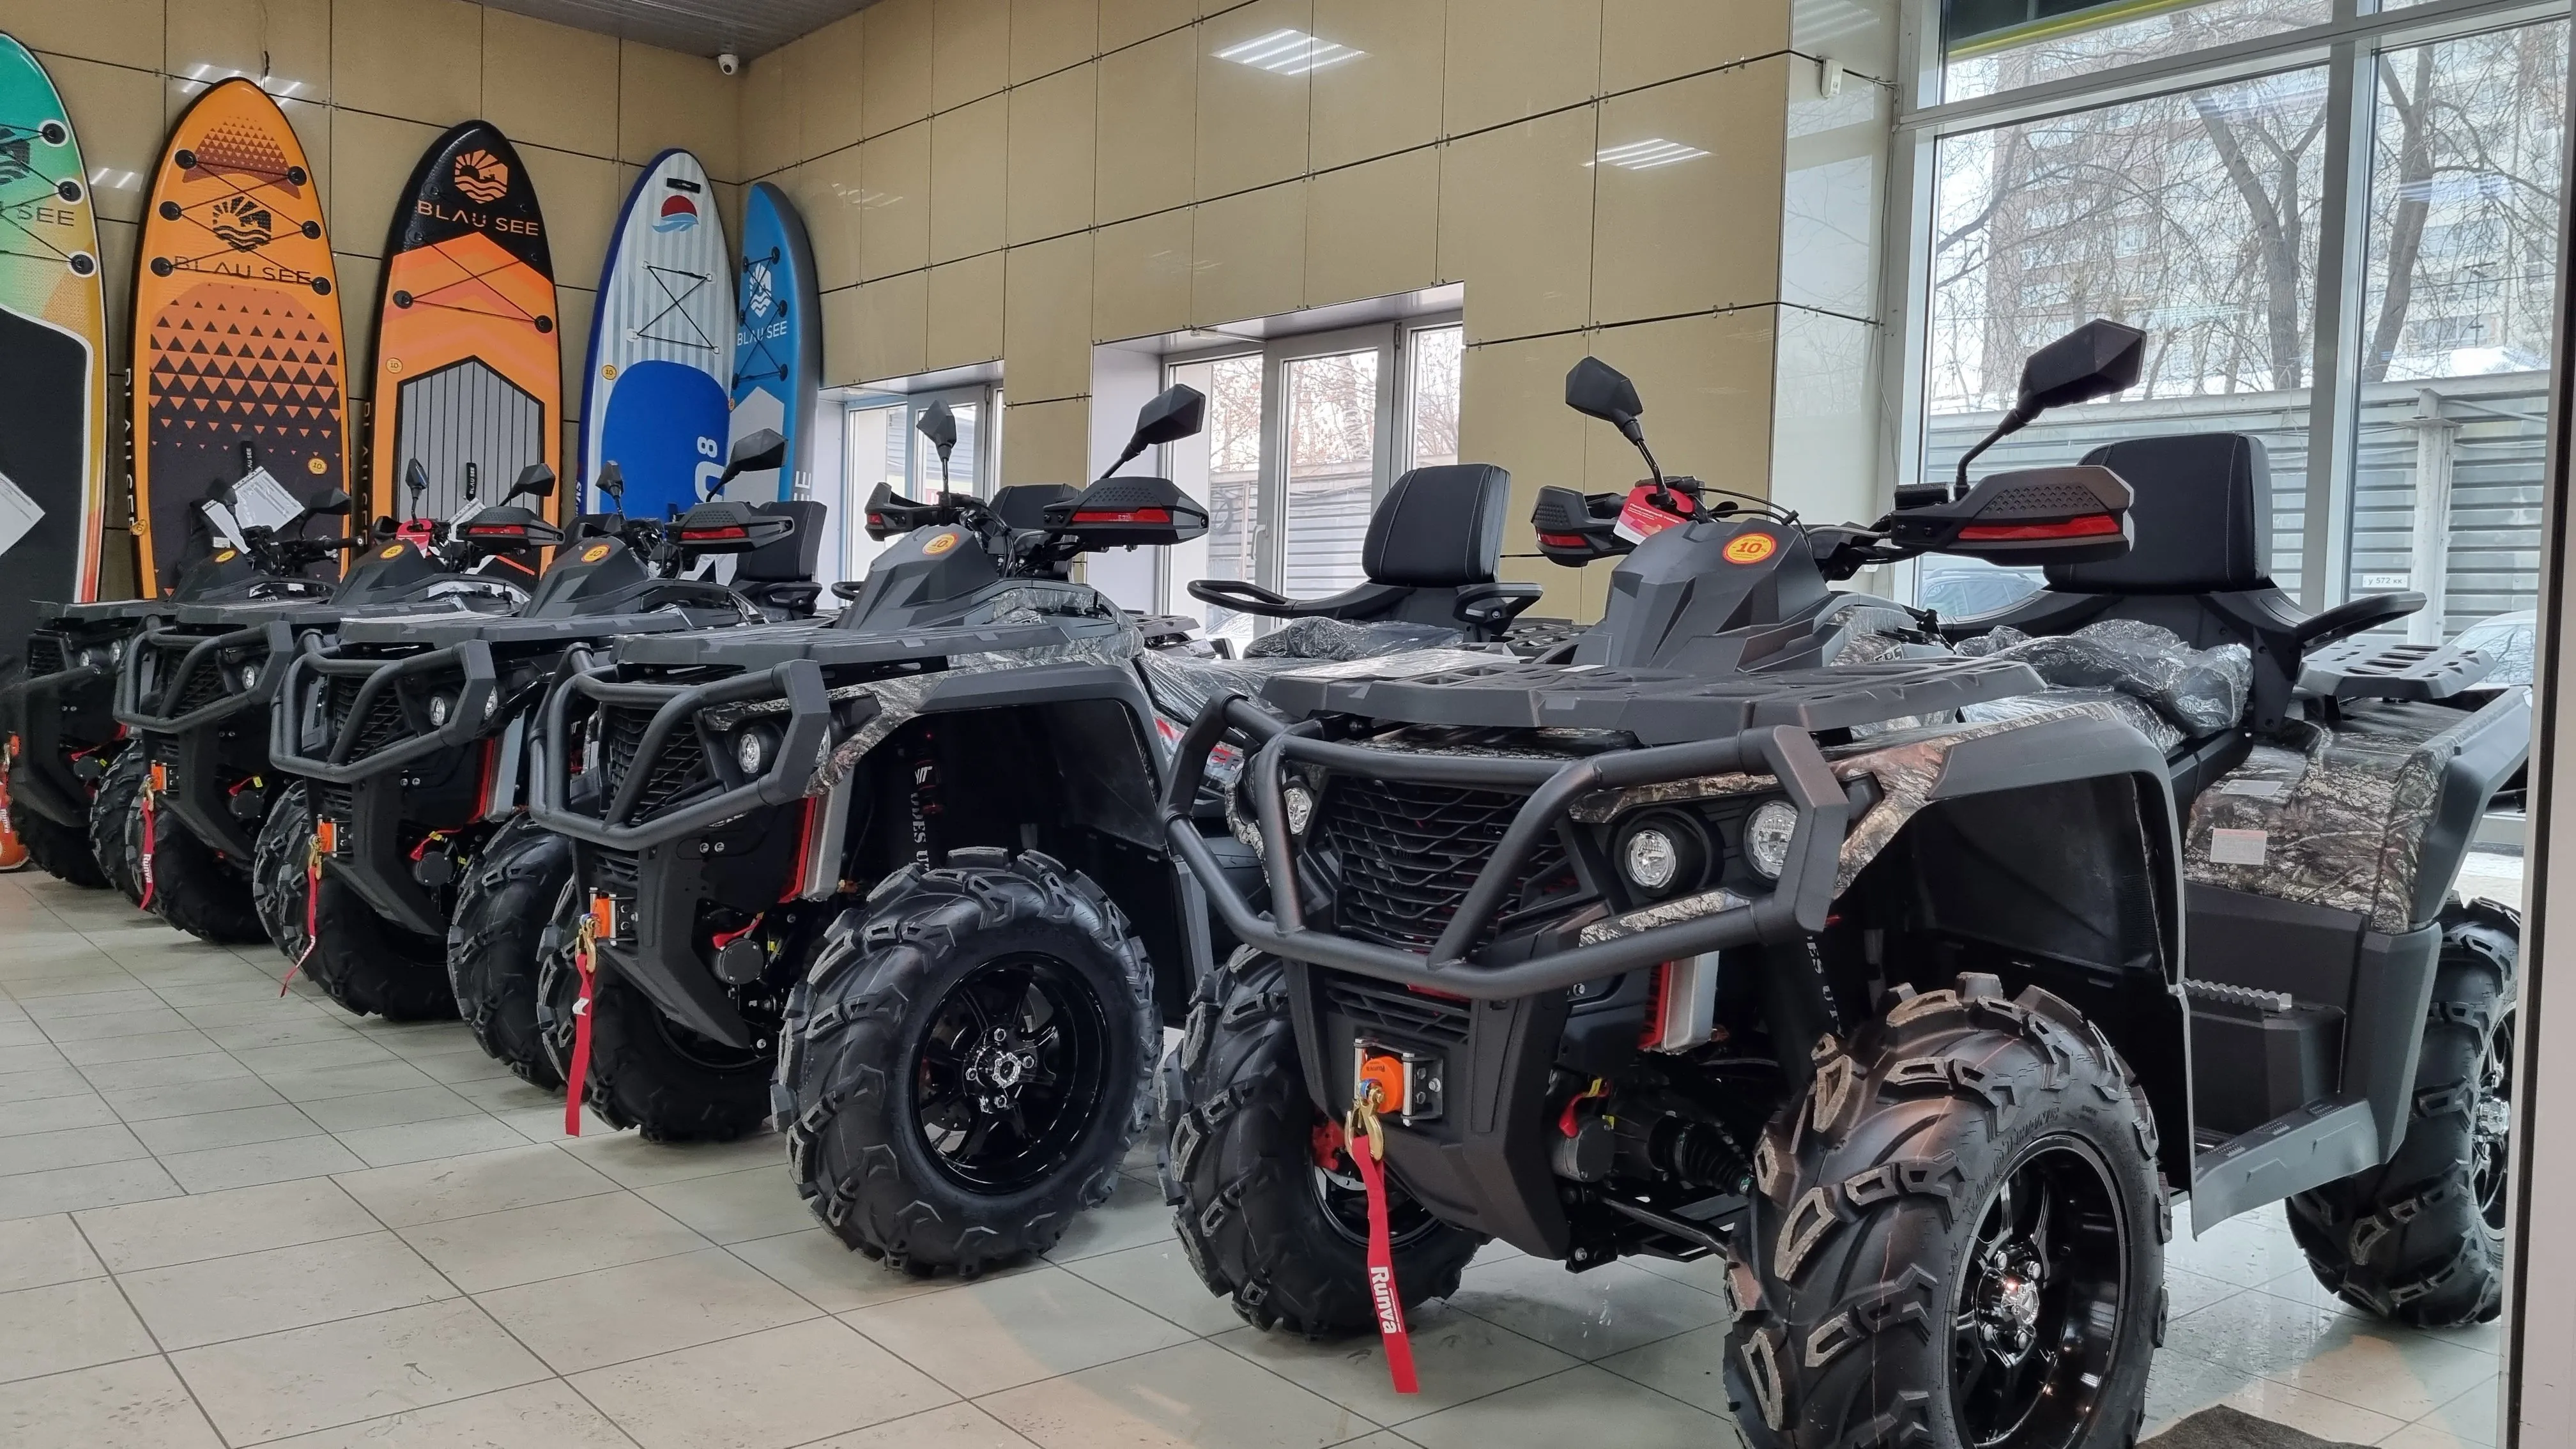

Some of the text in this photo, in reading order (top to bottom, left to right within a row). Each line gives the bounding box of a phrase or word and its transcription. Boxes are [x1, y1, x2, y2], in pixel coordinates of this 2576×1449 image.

[17, 203, 75, 227] SEE
[417, 193, 539, 236] BLAU SEE
[174, 256, 310, 284] BLAU SEE
[737, 321, 787, 346] BLAU SEE
[1370, 1266, 1397, 1333] Runva
